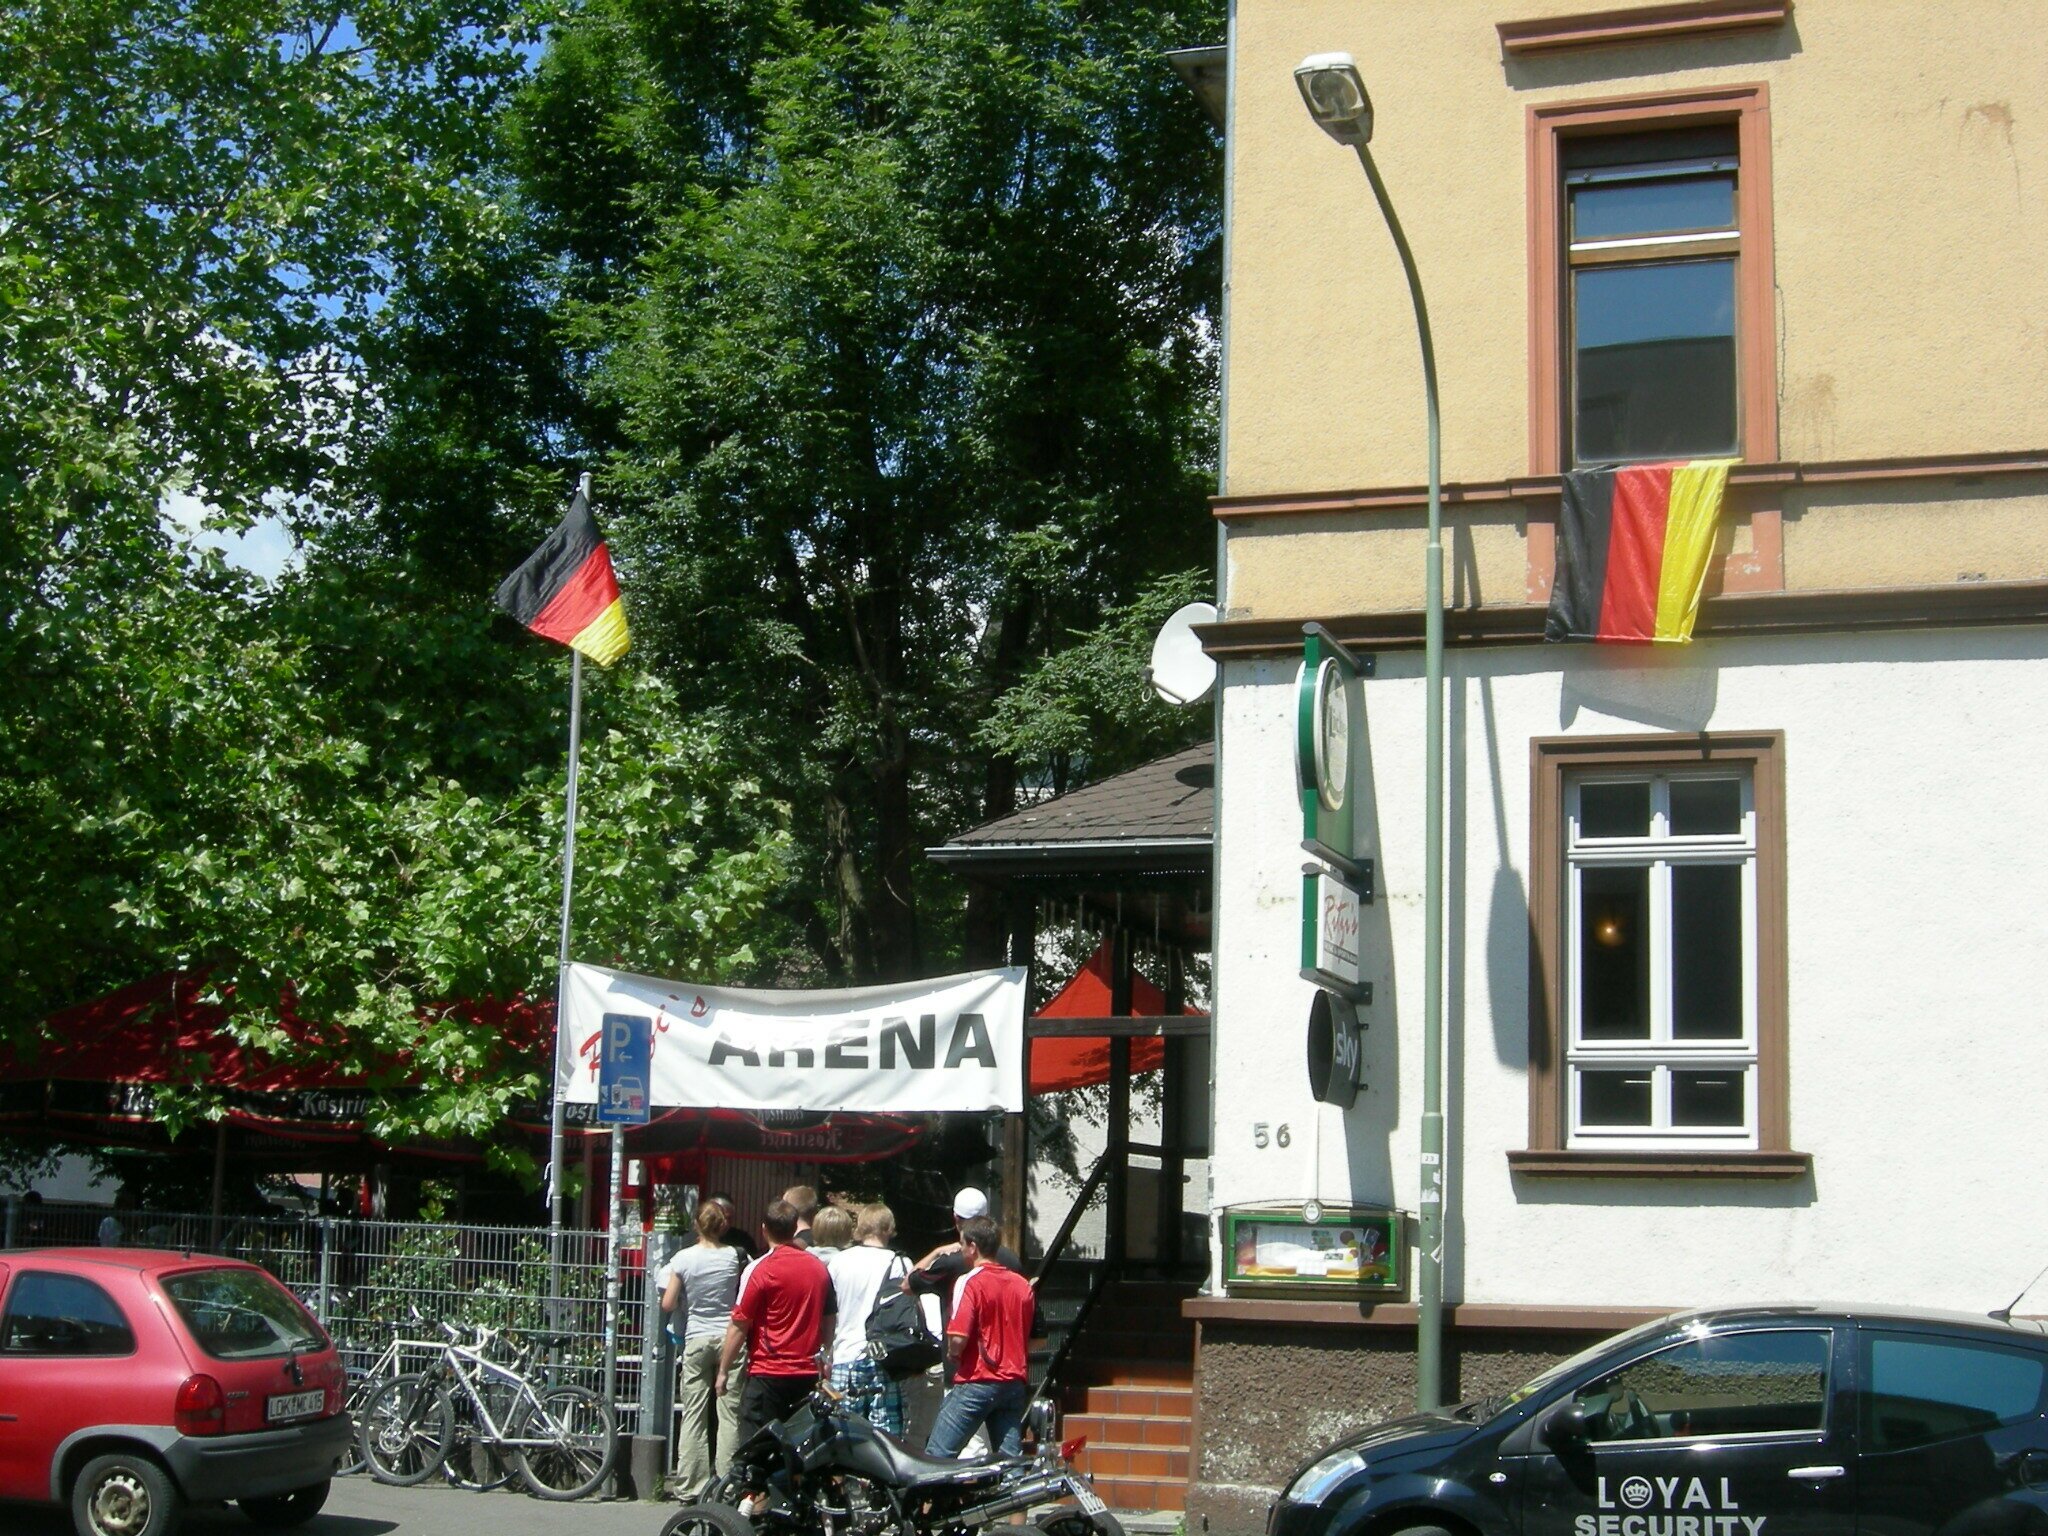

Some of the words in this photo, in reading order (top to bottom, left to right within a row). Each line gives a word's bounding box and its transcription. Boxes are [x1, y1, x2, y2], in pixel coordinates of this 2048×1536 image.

[609, 1021, 632, 1063] P
[1335, 1021, 1358, 1080] sky
[1253, 1122, 1291, 1149] 56
[1597, 1475, 1739, 1510] LOYAL
[1574, 1514, 1767, 1536] SECURITY
